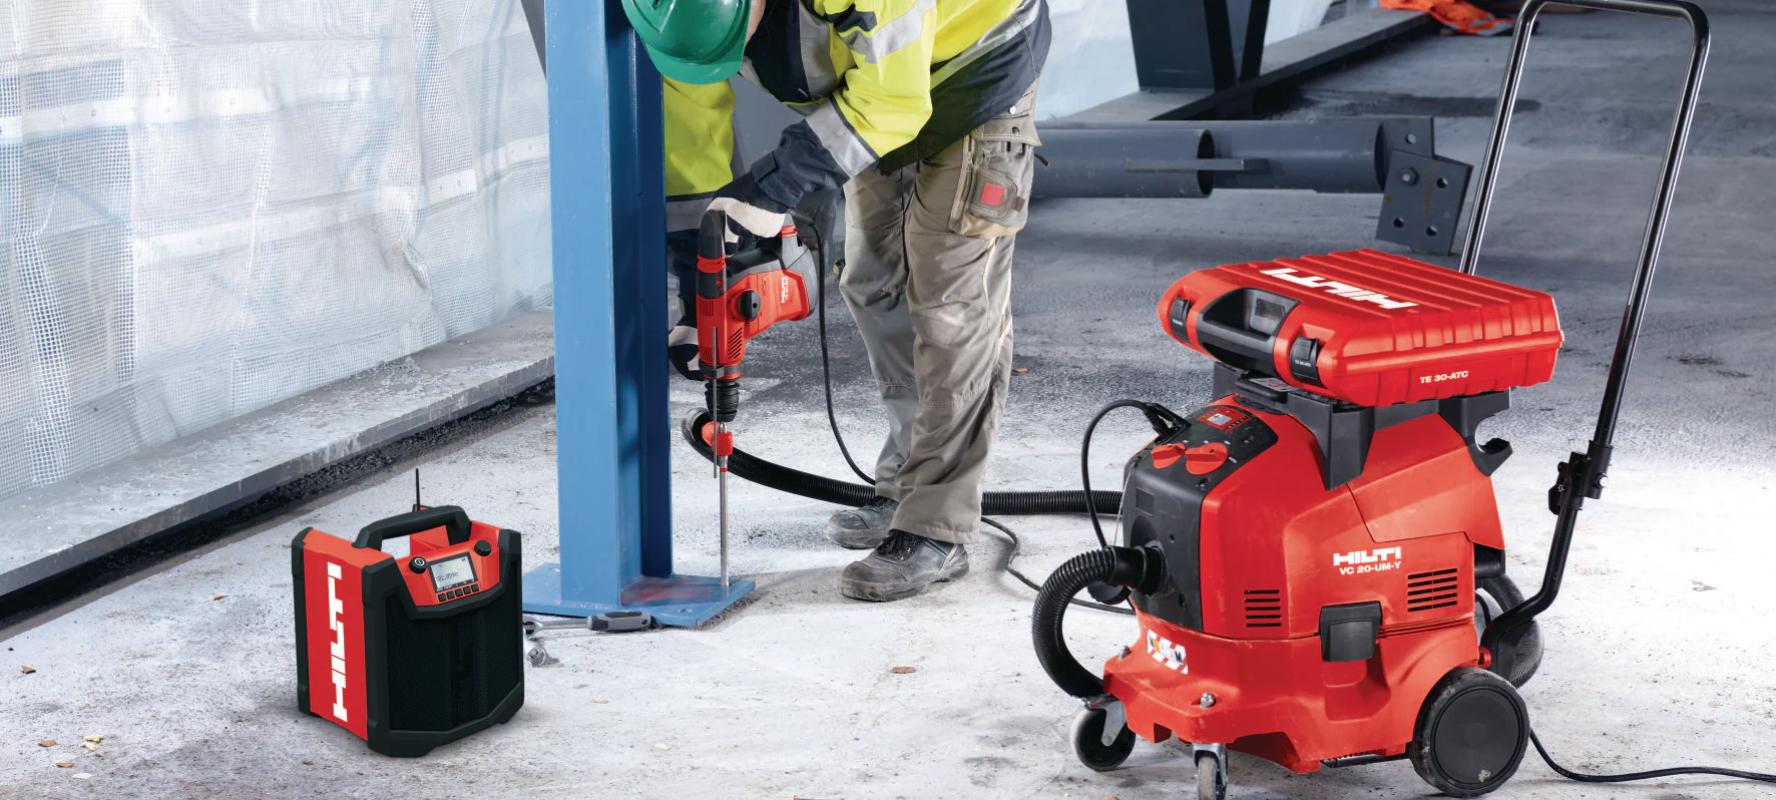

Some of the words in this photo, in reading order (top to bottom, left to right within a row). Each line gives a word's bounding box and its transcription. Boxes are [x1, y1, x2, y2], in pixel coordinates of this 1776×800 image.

[1259, 268, 1419, 309] HILTI
[1419, 375, 1432, 384] TE
[1433, 370, 1469, 382] 30-ATC
[1333, 546, 1401, 567] HILTI
[1339, 566, 1354, 576] VC
[1356, 561, 1401, 574] 20-UM-Y
[327, 562, 348, 722] HILTI
